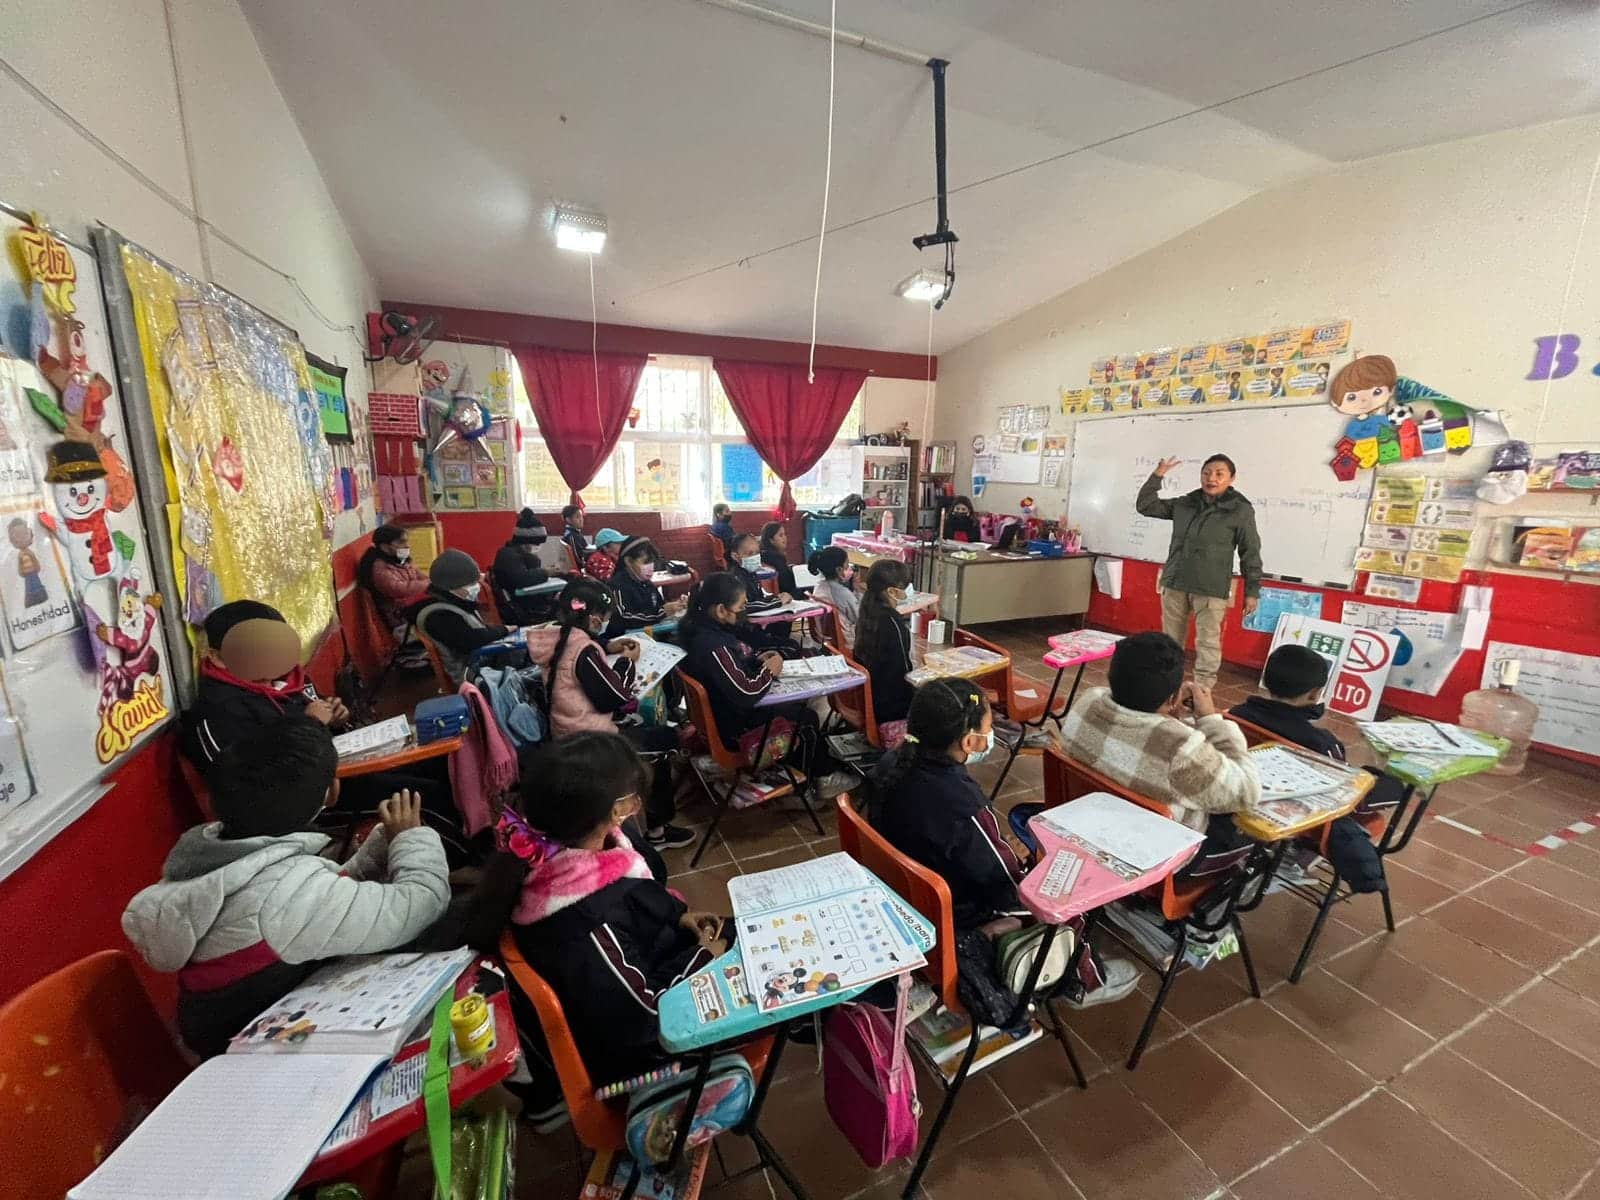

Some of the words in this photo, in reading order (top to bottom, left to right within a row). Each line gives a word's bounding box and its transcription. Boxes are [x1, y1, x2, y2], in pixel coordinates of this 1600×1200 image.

[23, 233, 73, 276] Feliz
[1524, 334, 1600, 380] B
[11, 600, 70, 633] Honestidad
[1333, 682, 1366, 706] LTO
